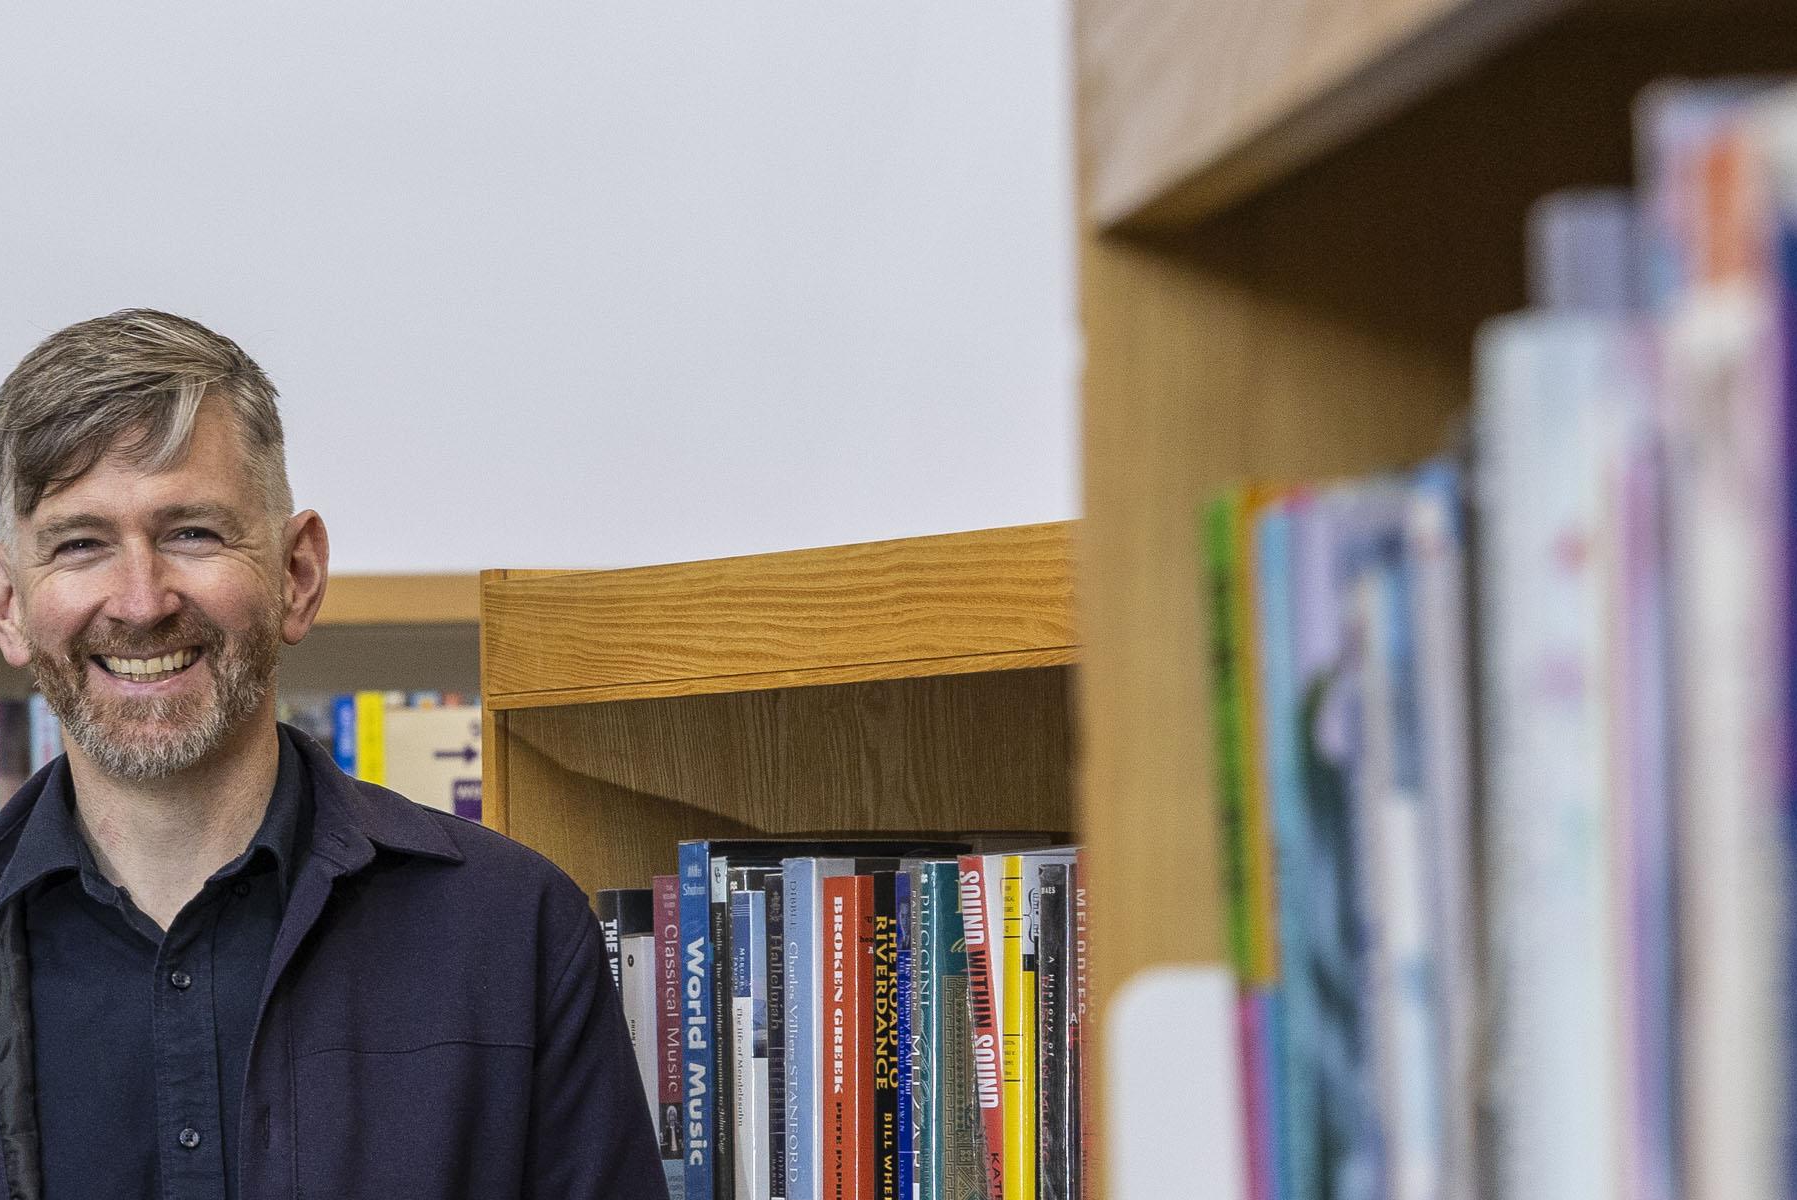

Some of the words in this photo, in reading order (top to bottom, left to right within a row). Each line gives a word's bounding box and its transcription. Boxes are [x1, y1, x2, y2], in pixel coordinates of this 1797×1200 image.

[889, 919, 898, 964] THE
[959, 870, 985, 945] SOUND
[663, 924, 680, 1018] Classical
[769, 933, 783, 1029] Hallelujah
[788, 941, 799, 1000] Charles
[833, 896, 843, 1002] BROKEN
[920, 895, 930, 1007] PUCCINI
[967, 949, 991, 1028] WITHIN
[686, 937, 707, 1049] World
[875, 916, 888, 1090] RIVERDANCE
[889, 971, 898, 1046] ROAD
[666, 1026, 682, 1093] Music
[788, 1004, 799, 1062] Villiers
[833, 1008, 844, 1093] GREEK
[889, 1055, 899, 1089] TO
[973, 1034, 999, 1109] SOUND
[686, 1062, 707, 1166] Music
[788, 1065, 800, 1183] STANFORD
[883, 1112, 893, 1150] BILL
